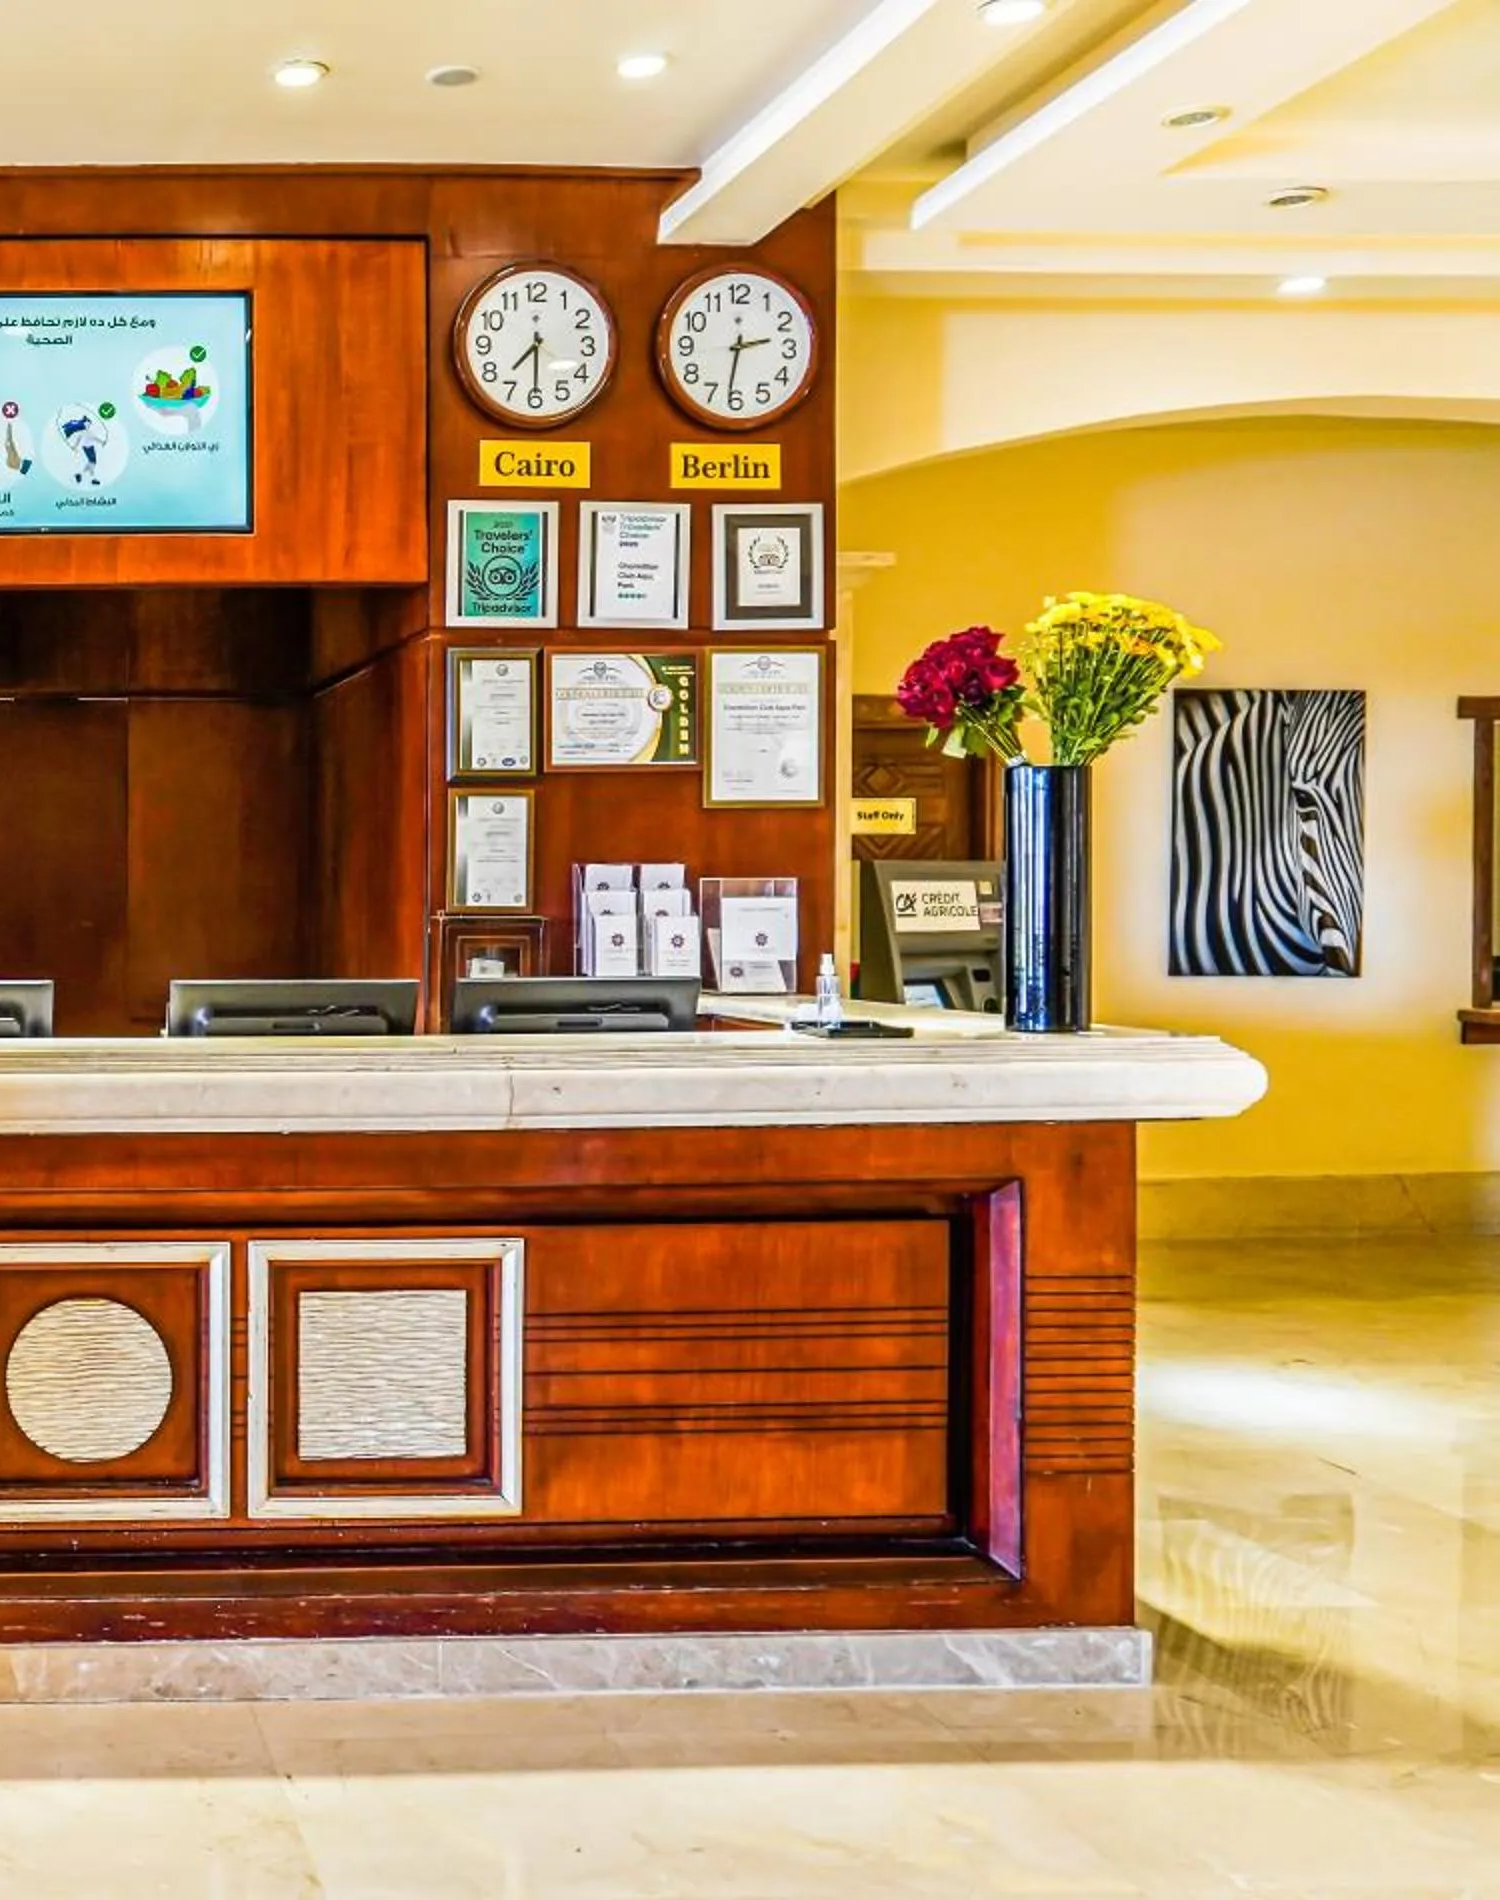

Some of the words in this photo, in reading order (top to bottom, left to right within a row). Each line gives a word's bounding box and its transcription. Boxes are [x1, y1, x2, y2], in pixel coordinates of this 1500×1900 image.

[501, 292, 517, 312] 11
[526, 282, 547, 302] 12
[560, 290, 567, 310] 1
[728, 284, 750, 304] 12
[762, 293, 770, 311] 1
[704, 293, 720, 313] 11
[62, 316, 88, 329] لازم
[107, 316, 127, 329] كل
[482, 311, 504, 331] 10
[575, 309, 590, 329] 2
[685, 312, 707, 332] 10
[778, 311, 792, 332] 2
[26, 333, 73, 345] الصحية
[476, 336, 491, 355] 9
[581, 336, 595, 356] 3
[678, 336, 694, 356] 9
[782, 339, 796, 359] 3
[482, 362, 497, 382] 8
[574, 363, 589, 383] 4
[684, 363, 699, 384] 8
[774, 366, 789, 386] 4
[503, 381, 516, 401] 7
[528, 389, 542, 408] 6
[556, 380, 570, 401] 5
[704, 383, 718, 403] 7
[729, 391, 743, 410] 6
[756, 383, 770, 404] 5
[494, 450, 576, 477] Cairo
[682, 453, 771, 479] Berlin
[473, 529, 533, 541] Travelers'
[481, 541, 526, 553] Choice
[472, 602, 532, 614] Tripadvisor
[856, 811, 880, 821] Staff
[881, 811, 905, 821] Only
[923, 905, 979, 917] AGRICOLE
